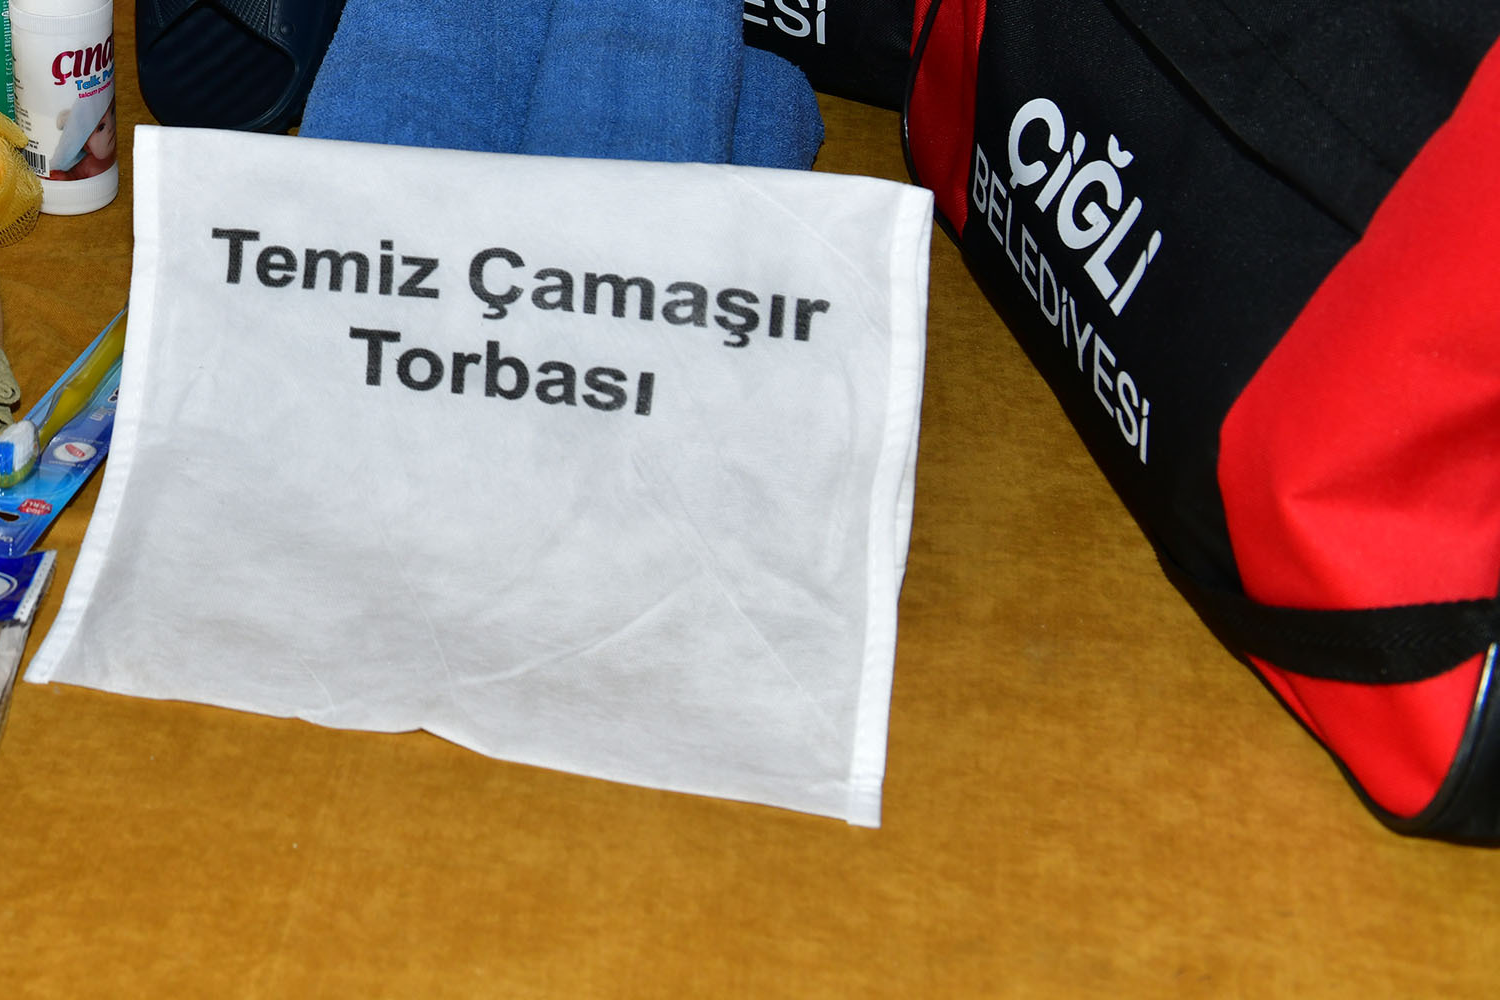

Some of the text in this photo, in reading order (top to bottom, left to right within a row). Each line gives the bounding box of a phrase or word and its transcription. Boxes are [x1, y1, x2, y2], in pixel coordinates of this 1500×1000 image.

[211, 227, 831, 349] Temiz Çamaşır
[1008, 97, 1162, 316] ÇİĞLİ
[349, 326, 655, 417] Torbası
[972, 143, 1150, 465] BELEDİYESİ
